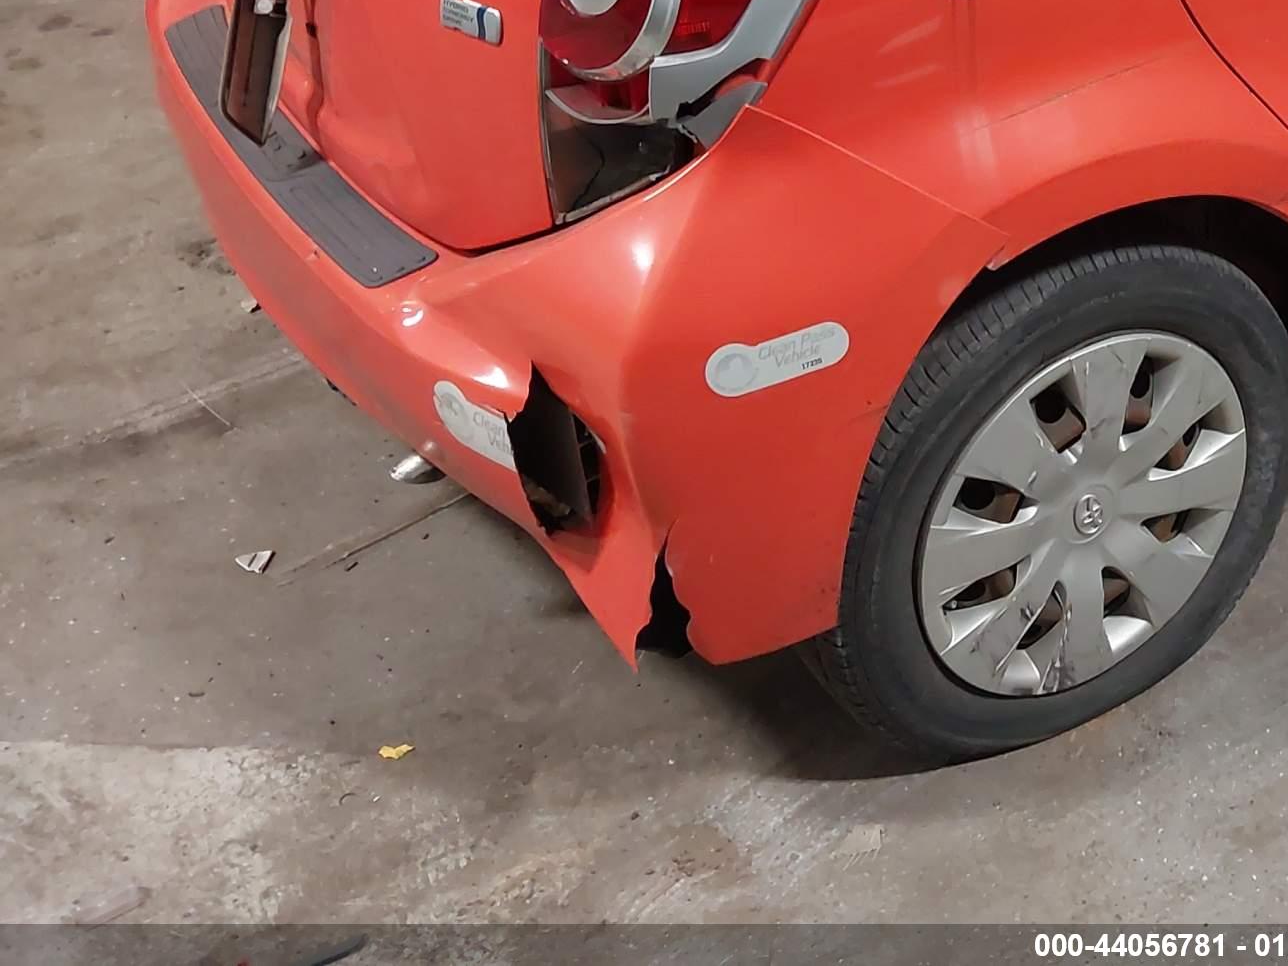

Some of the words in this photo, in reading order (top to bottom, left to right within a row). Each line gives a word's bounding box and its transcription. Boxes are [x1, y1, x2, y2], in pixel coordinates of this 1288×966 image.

[758, 340, 796, 361] Clean
[800, 326, 836, 345] Pass
[775, 344, 822, 368] Vehicle
[473, 411, 507, 438] Clean
